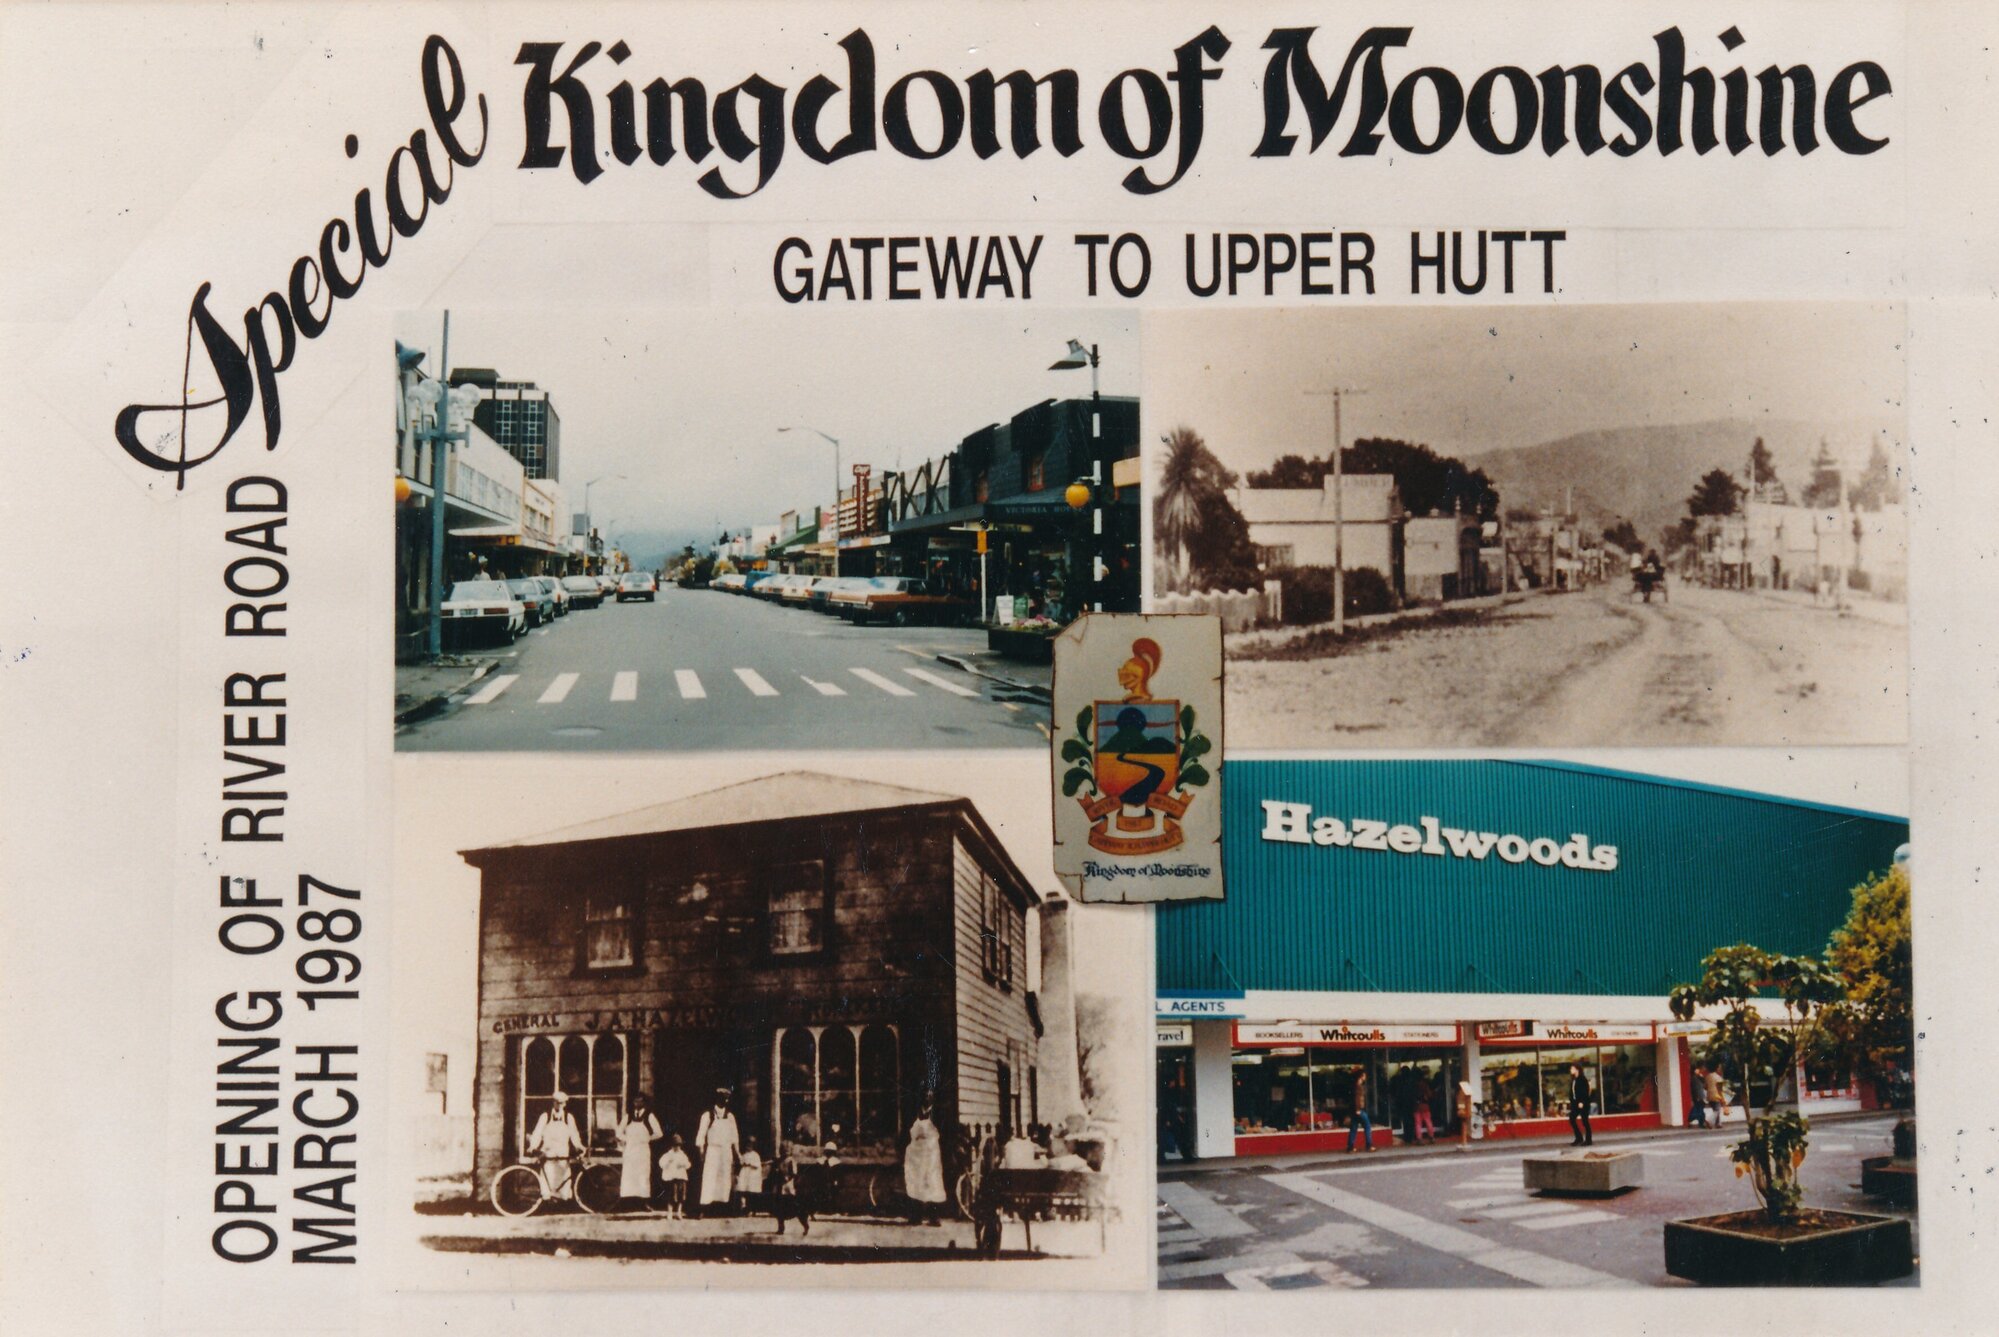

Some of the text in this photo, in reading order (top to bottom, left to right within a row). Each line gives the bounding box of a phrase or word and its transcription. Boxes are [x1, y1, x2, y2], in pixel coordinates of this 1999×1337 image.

[515, 25, 1893, 199] Kingdom of Moonshine
[115, 34, 488, 490] Special
[774, 231, 1566, 303] GATEWAY TO UPPER HUTT
[212, 476, 290, 1263] OPENING OF RIVER ROAD
[1082, 861, 1211, 880] Kingdom of Moonshine
[1261, 799, 1619, 872] Hazelwoods
[493, 1014, 559, 1034] GENERAL
[1170, 1001, 1225, 1012] AGENTS
[1255, 1031, 1304, 1039] BOOKSELLERS
[1320, 1026, 1386, 1041] Whitcoulls
[1546, 1025, 1599, 1040] Whitcoulls
[293, 875, 361, 1263] MARCH 1987
